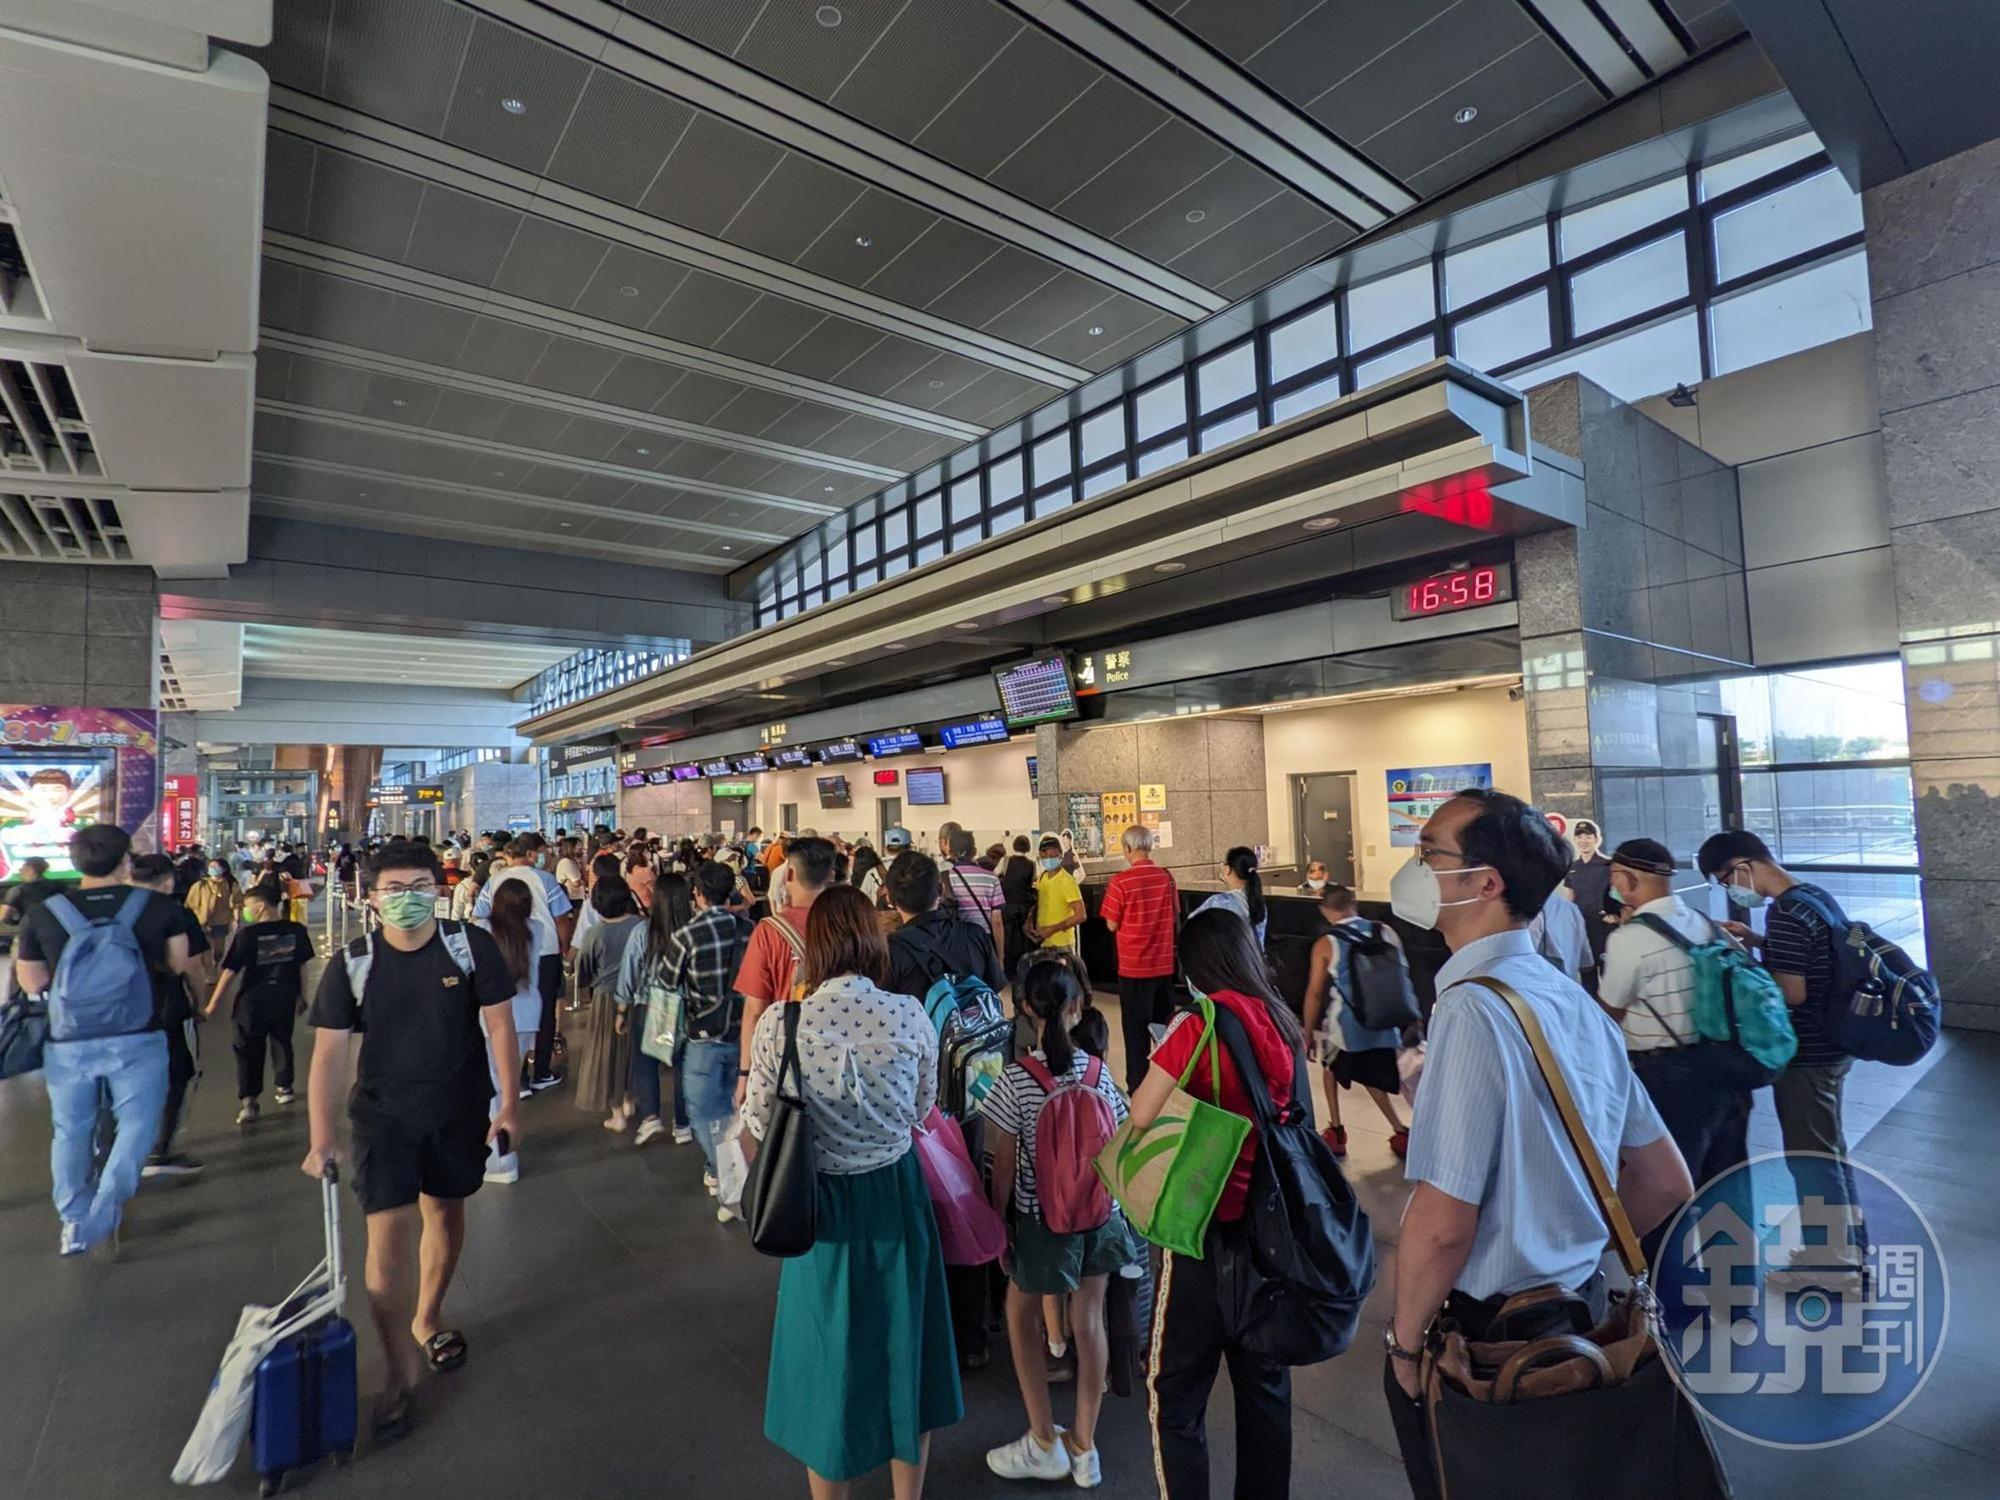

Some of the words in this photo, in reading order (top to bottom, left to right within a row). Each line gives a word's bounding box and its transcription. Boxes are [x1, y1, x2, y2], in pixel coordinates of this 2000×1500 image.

[1412, 571, 1494, 610] 16:58
[1105, 650, 1131, 670] 警察
[1106, 671, 1129, 683] Police
